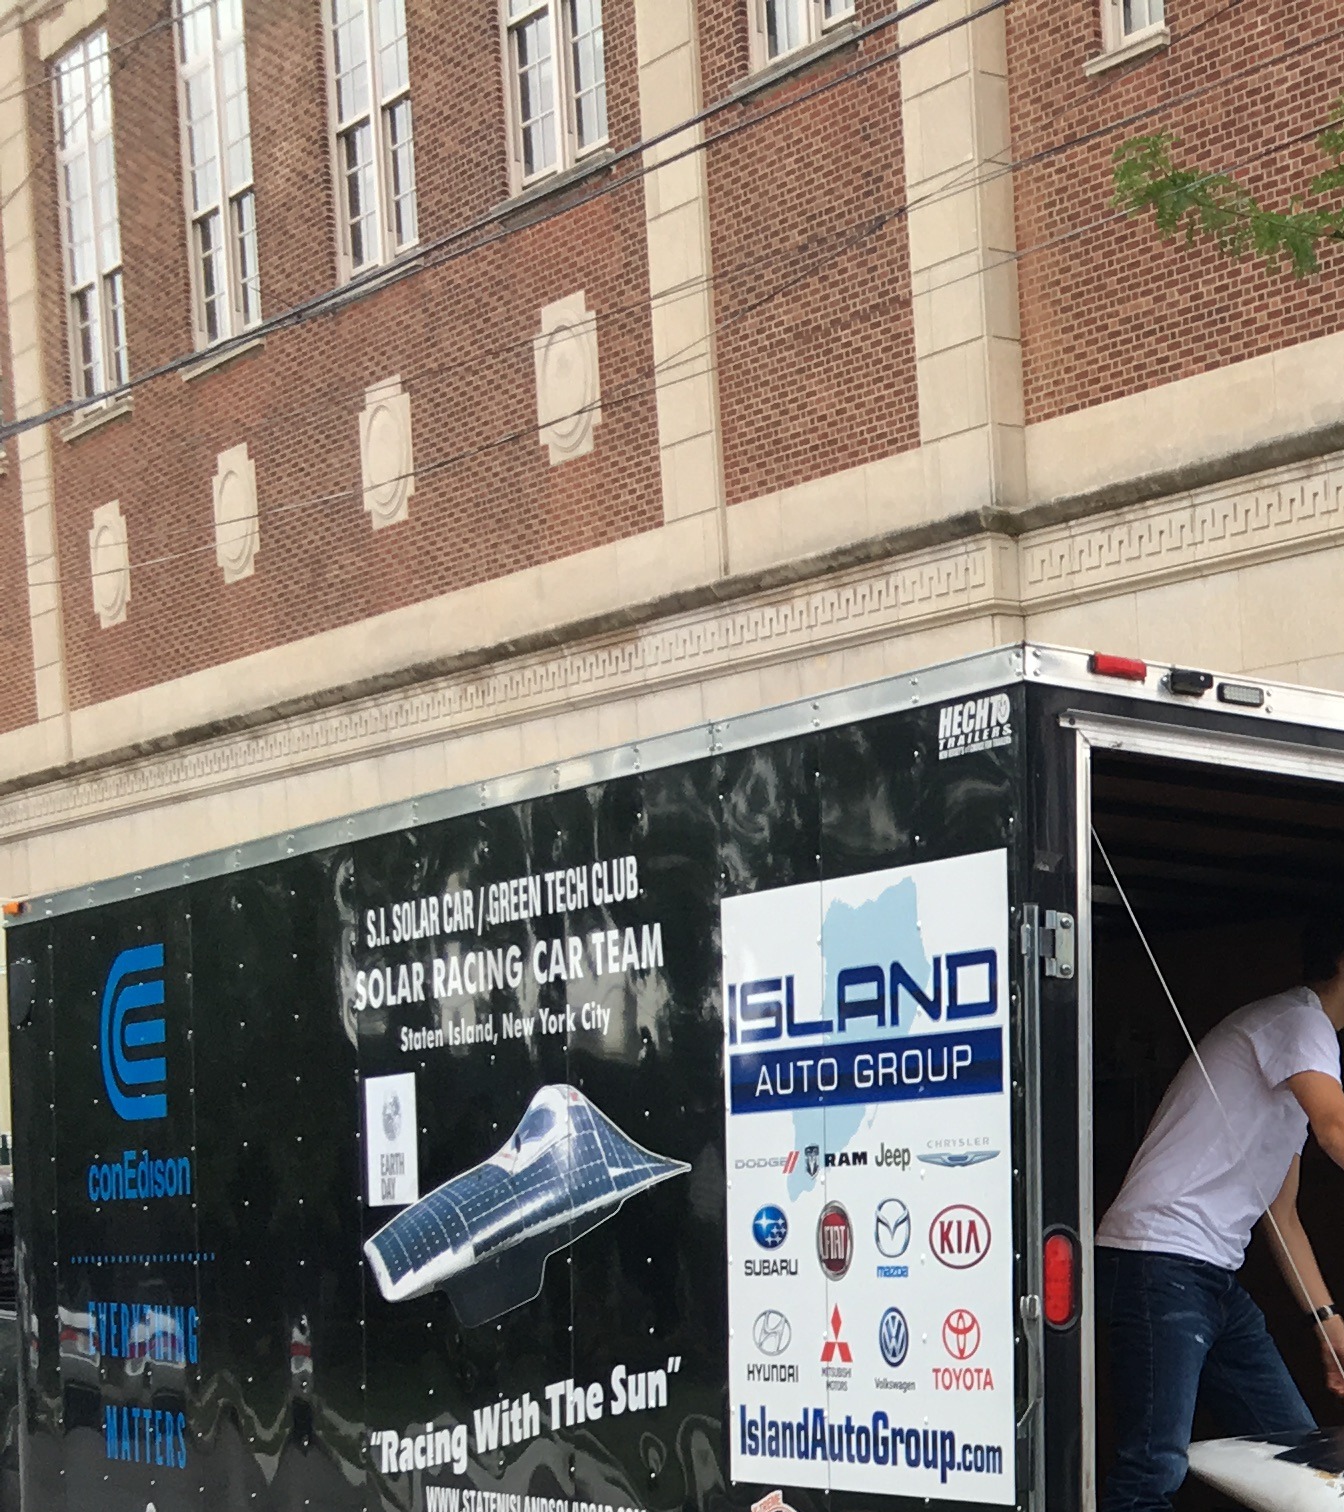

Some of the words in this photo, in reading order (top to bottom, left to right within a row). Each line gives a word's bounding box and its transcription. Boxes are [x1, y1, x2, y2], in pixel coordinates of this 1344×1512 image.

[939, 724, 1012, 750] TRAILERS
[366, 907, 390, 948] S.I.
[392, 896, 440, 943] SOLAR
[443, 889, 474, 933] CAR
[489, 875, 541, 925] GREEN
[544, 865, 589, 914] TECH
[591, 855, 639, 905] CLUB
[355, 962, 425, 1011] SOLAR
[433, 944, 524, 999] RACING
[533, 936, 584, 985] CAR
[591, 922, 664, 976] TEAM
[728, 946, 998, 1046] ISLAND
[400, 1026, 444, 1052] Staten
[449, 1013, 498, 1046] Island,
[502, 1012, 535, 1040] New
[538, 1003, 576, 1035] York
[581, 1000, 611, 1036] City
[754, 1058, 838, 1098] AUTO
[854, 1044, 973, 1088] GROUP
[825, 1151, 868, 1168] RAM
[875, 1142, 911, 1171] Jeep
[926, 1136, 990, 1149] CHRYSLER
[88, 1149, 191, 1202] conEdison
[380, 1152, 405, 1176] EARTH
[735, 1157, 787, 1170] DODGE
[381, 1177, 396, 1200] DAY
[821, 1225, 848, 1260] FIAT
[939, 1219, 981, 1254] KIA
[744, 1259, 798, 1277] SUBARU
[876, 1265, 909, 1278] mazda
[88, 1300, 198, 1365] EVERYTHING
[747, 1363, 799, 1383] HYUNDAI
[932, 1368, 995, 1391] TOYOTA
[472, 1391, 541, 1455] With
[545, 1378, 604, 1431] The
[106, 1405, 187, 1469] MATTERS
[740, 1404, 1003, 1484] IslandAutoGroup.com
